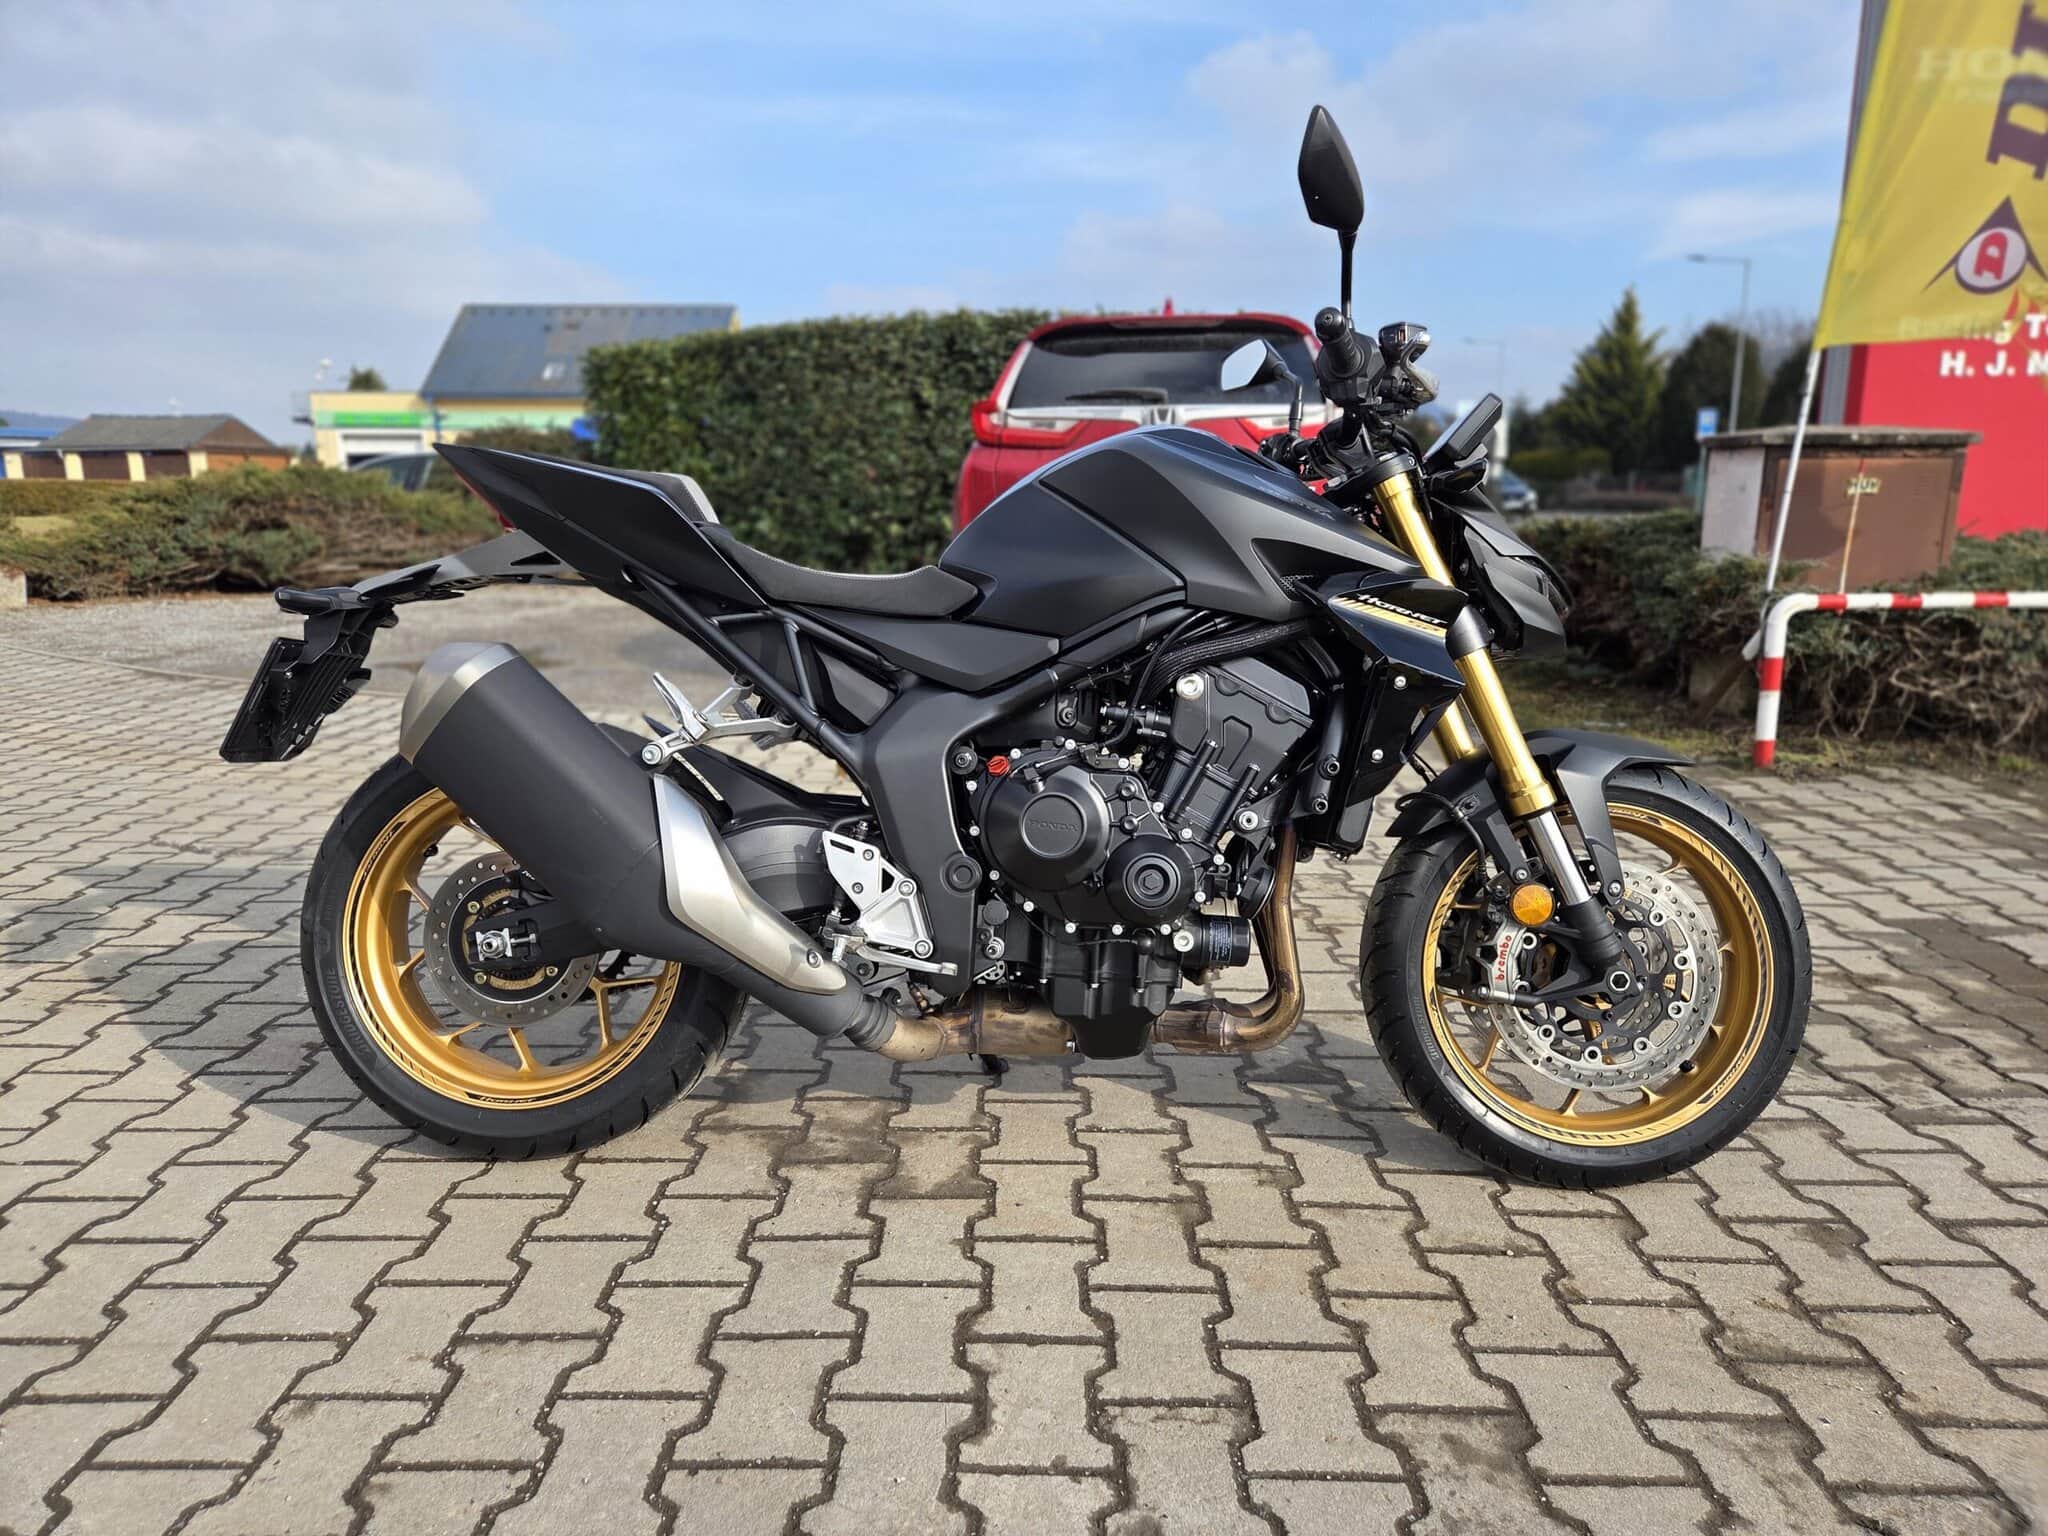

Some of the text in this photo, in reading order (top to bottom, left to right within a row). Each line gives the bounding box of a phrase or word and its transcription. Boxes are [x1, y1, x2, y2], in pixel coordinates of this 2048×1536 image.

[2025, 312, 2048, 339] T
[1939, 350, 1976, 377] H.
[1984, 349, 2016, 377] J.
[1495, 935, 1512, 981] brembo
